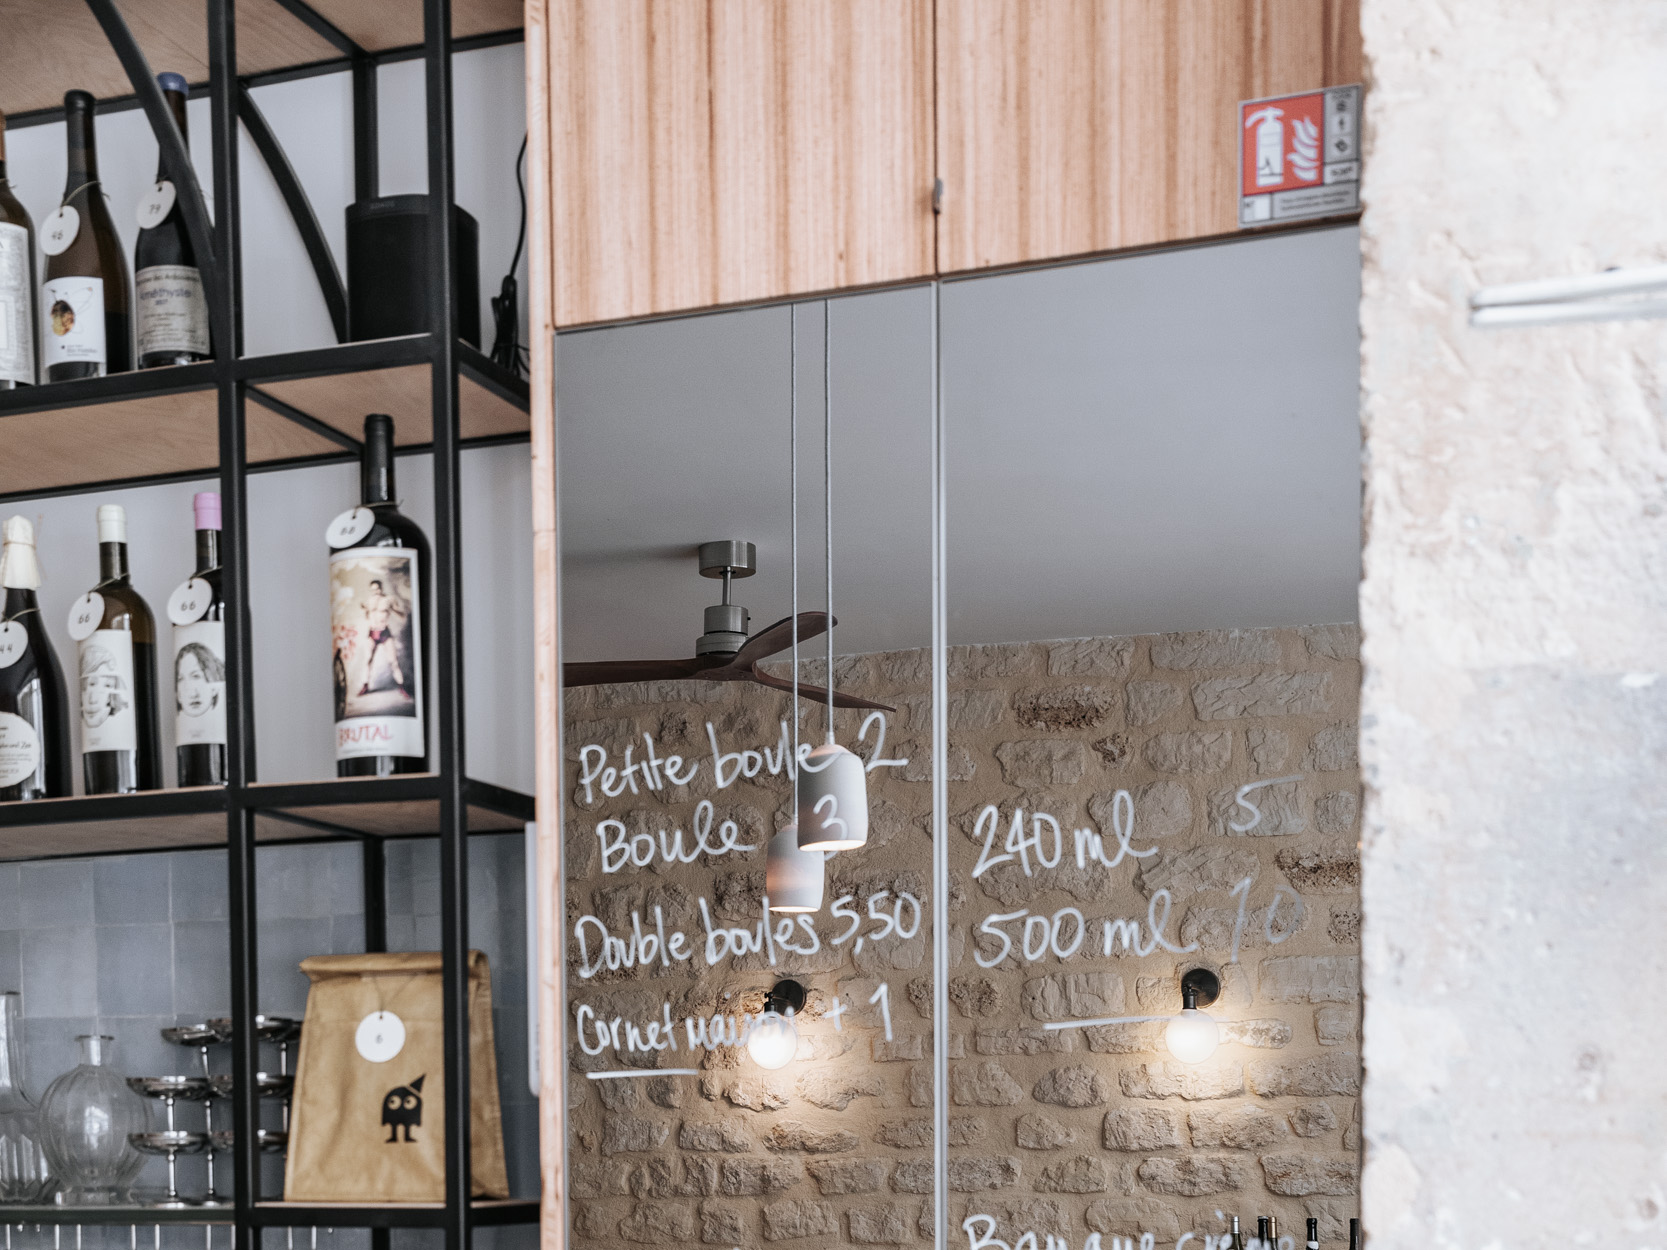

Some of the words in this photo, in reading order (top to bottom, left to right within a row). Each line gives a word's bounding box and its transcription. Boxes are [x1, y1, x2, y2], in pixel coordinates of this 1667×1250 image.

[78, 613, 90, 624] 66
[180, 600, 196, 611] 66
[580, 731, 698, 804] Petite
[706, 720, 843, 788] boule
[858, 711, 908, 773] 2
[597, 800, 757, 874] Boule
[813, 793, 849, 862] 3
[971, 805, 1063, 878] 240
[1074, 789, 1160, 868] ml
[1230, 775, 1304, 832] 5
[574, 905, 693, 980] Double
[700, 896, 820, 966] boules
[830, 891, 921, 955] 5,50
[974, 906, 1086, 968] 500
[1103, 888, 1198, 959] ml
[1230, 877, 1303, 962] 10
[576, 1002, 678, 1056] Cornet
[822, 996, 848, 1031] +
[869, 982, 893, 1043] 1
